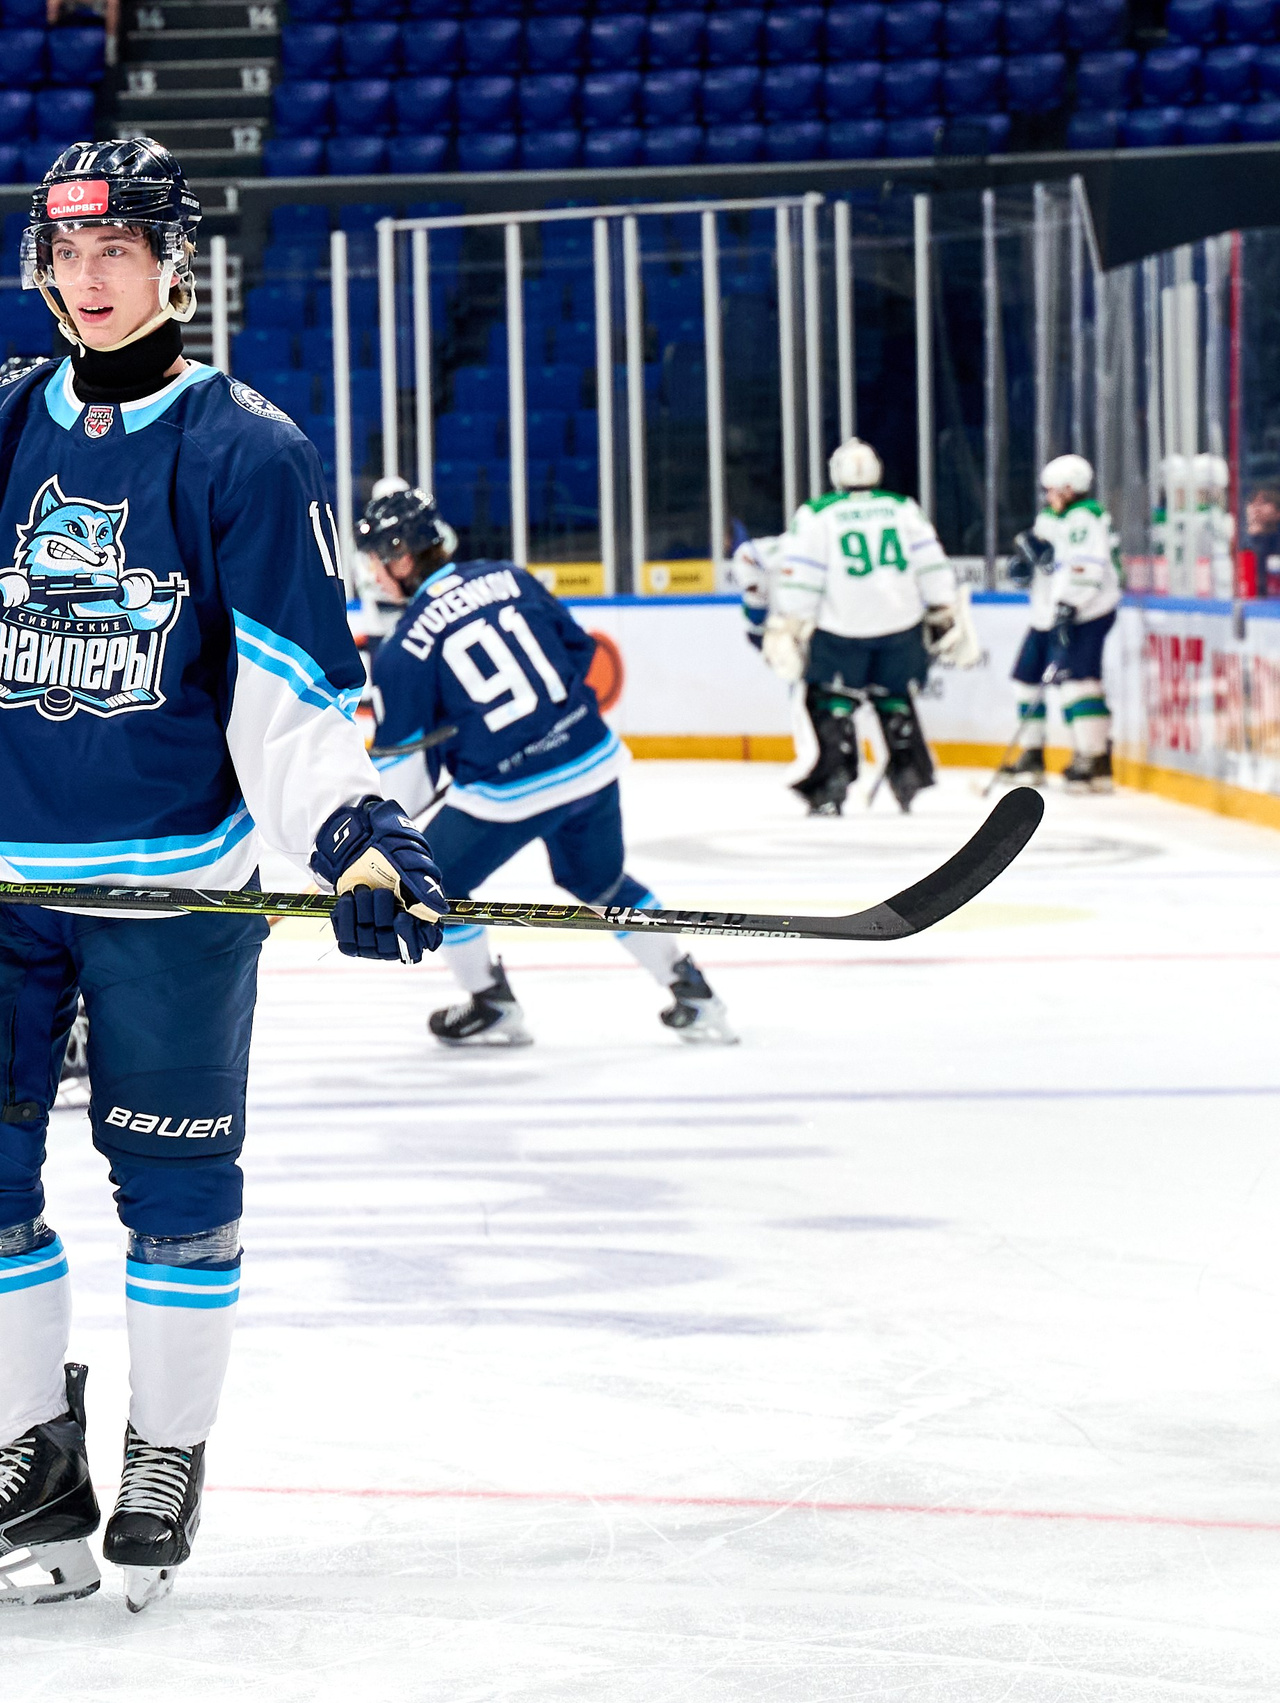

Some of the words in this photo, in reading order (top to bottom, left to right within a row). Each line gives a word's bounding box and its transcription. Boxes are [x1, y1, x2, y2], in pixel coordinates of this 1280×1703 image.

[74, 151, 99, 171] 11
[50, 202, 104, 215] OLIMPBET
[309, 501, 344, 578] 11
[840, 527, 908, 577] 94
[18, 612, 121, 632] СИБИРСКИЕ
[442, 605, 568, 733] 91
[108, 889, 172, 898] ETS
[680, 926, 802, 939] SHERWOOD
[105, 1106, 232, 1138] BAUER
